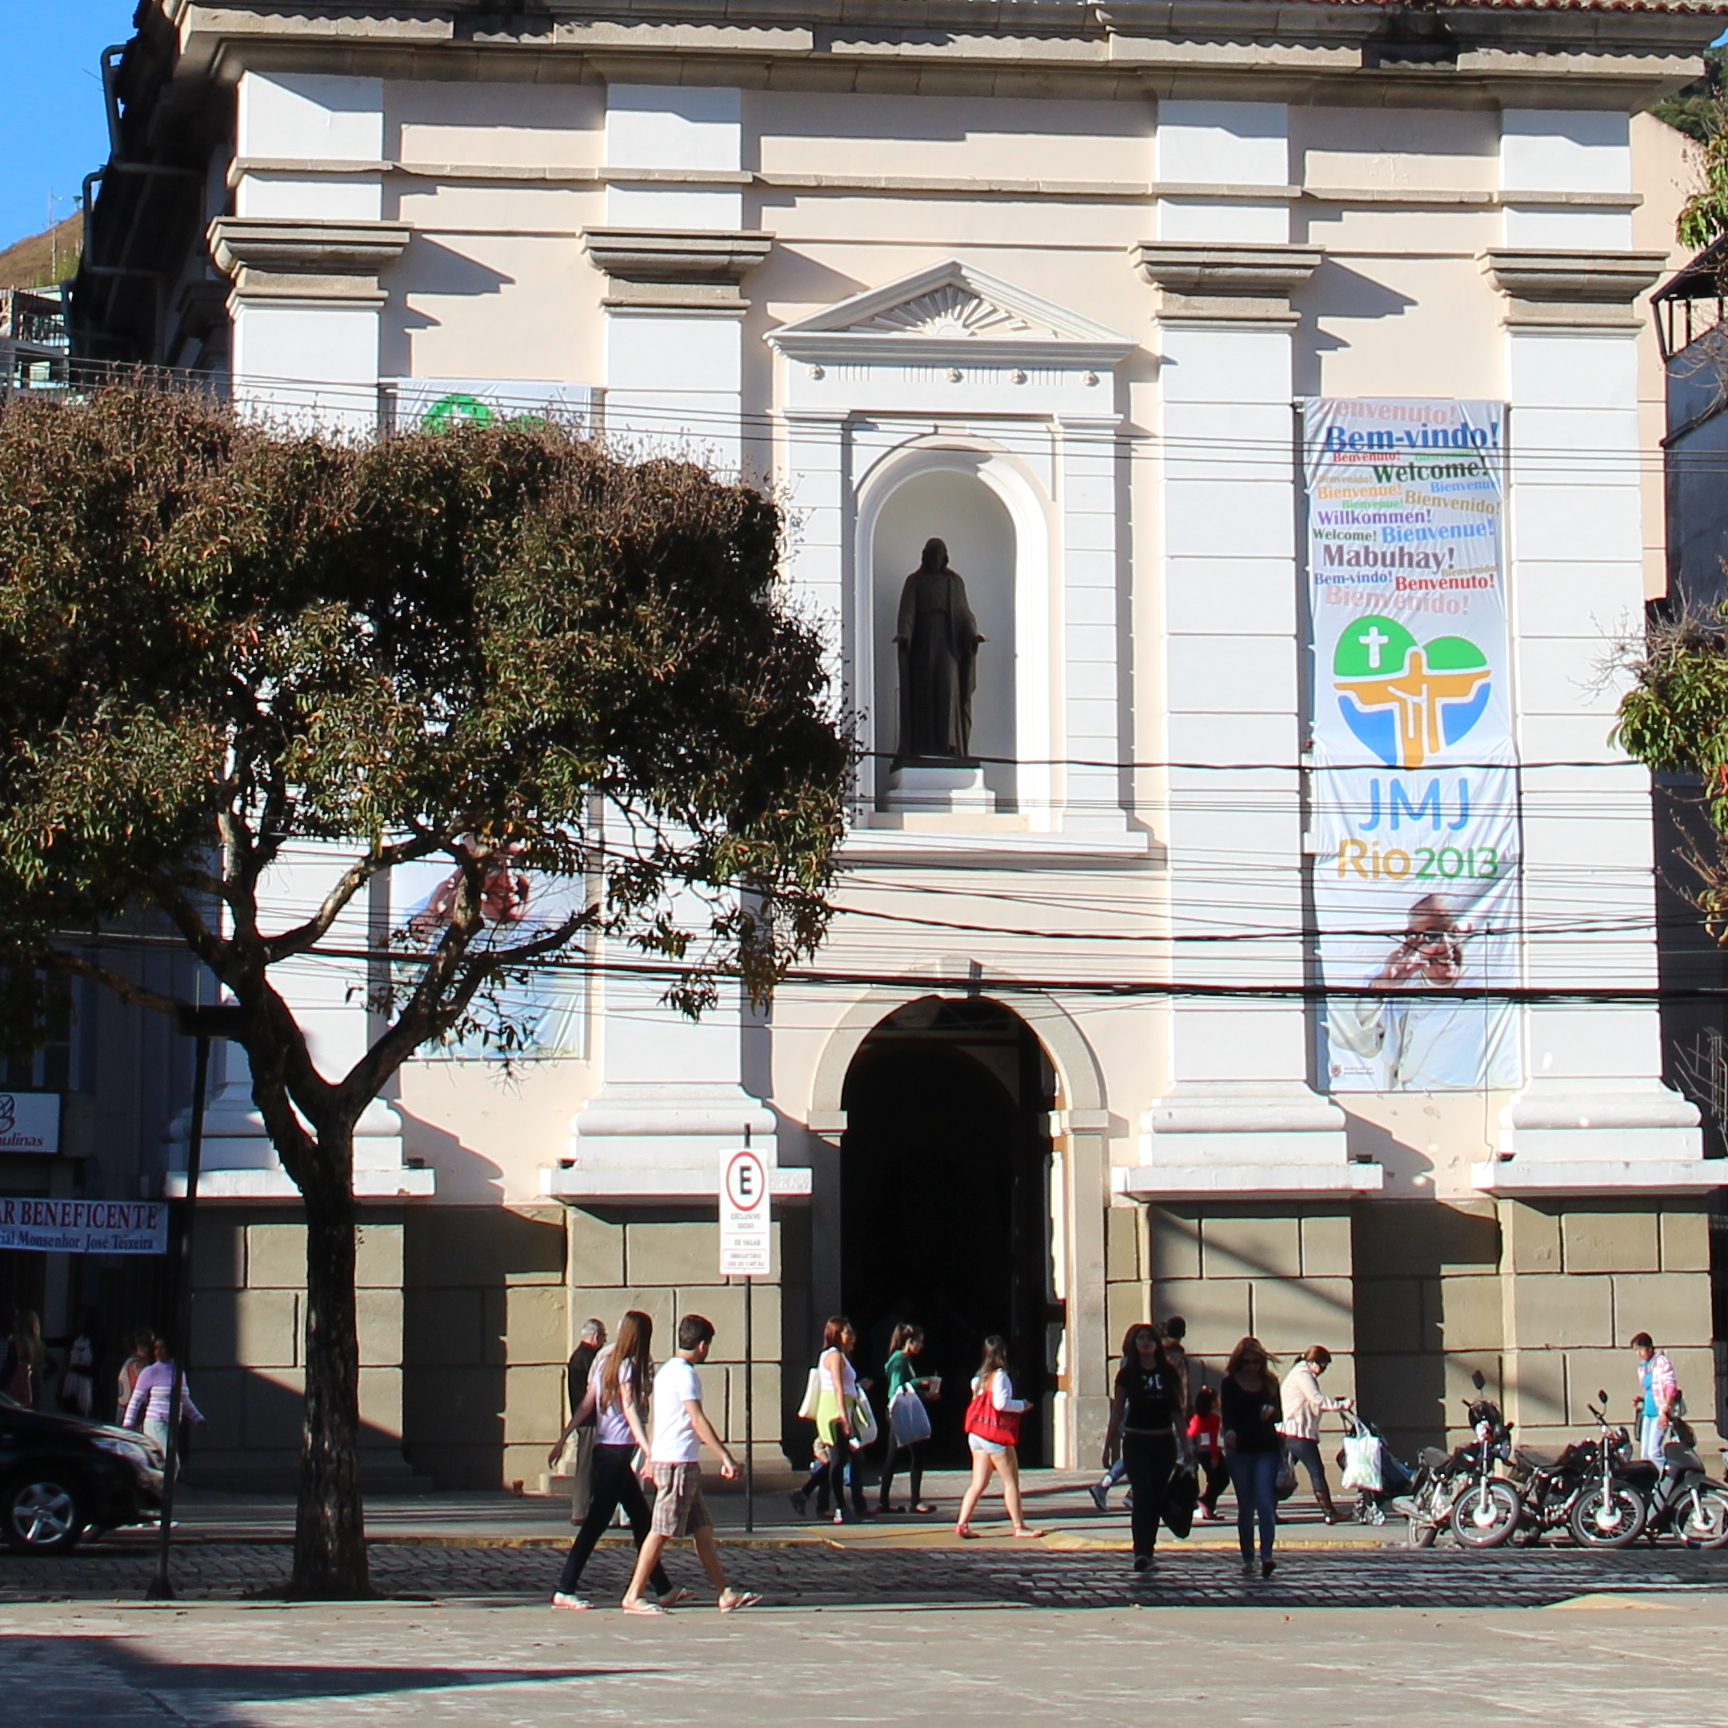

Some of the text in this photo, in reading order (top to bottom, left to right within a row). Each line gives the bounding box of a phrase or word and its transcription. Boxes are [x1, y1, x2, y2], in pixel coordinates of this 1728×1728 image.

[1324, 398, 1457, 425] envenuto!
[1326, 422, 1500, 452] Bem-vindo!
[1333, 450, 1401, 463] Benvenuto!
[1373, 460, 1489, 484] Welcome!
[1317, 483, 1402, 500] Bienvenue!
[1404, 490, 1502, 515] Bienvenido!
[1317, 509, 1432, 526] Willkommen!
[1312, 528, 1377, 542] Welcome!
[1382, 519, 1496, 544] Bienvenue!
[1323, 543, 1455, 575] Mabuhay!
[1314, 571, 1393, 586] Bem-vindo!
[1394, 574, 1495, 591] Benvenuto!
[1358, 777, 1470, 832] JMJ
[739, 1165, 753, 1195] E
[21, 1201, 159, 1230] BENEFICENTE
[18, 1231, 80, 1249] Monsenhor
[84, 1234, 108, 1252] José
[112, 1234, 154, 1250] Teixeira
